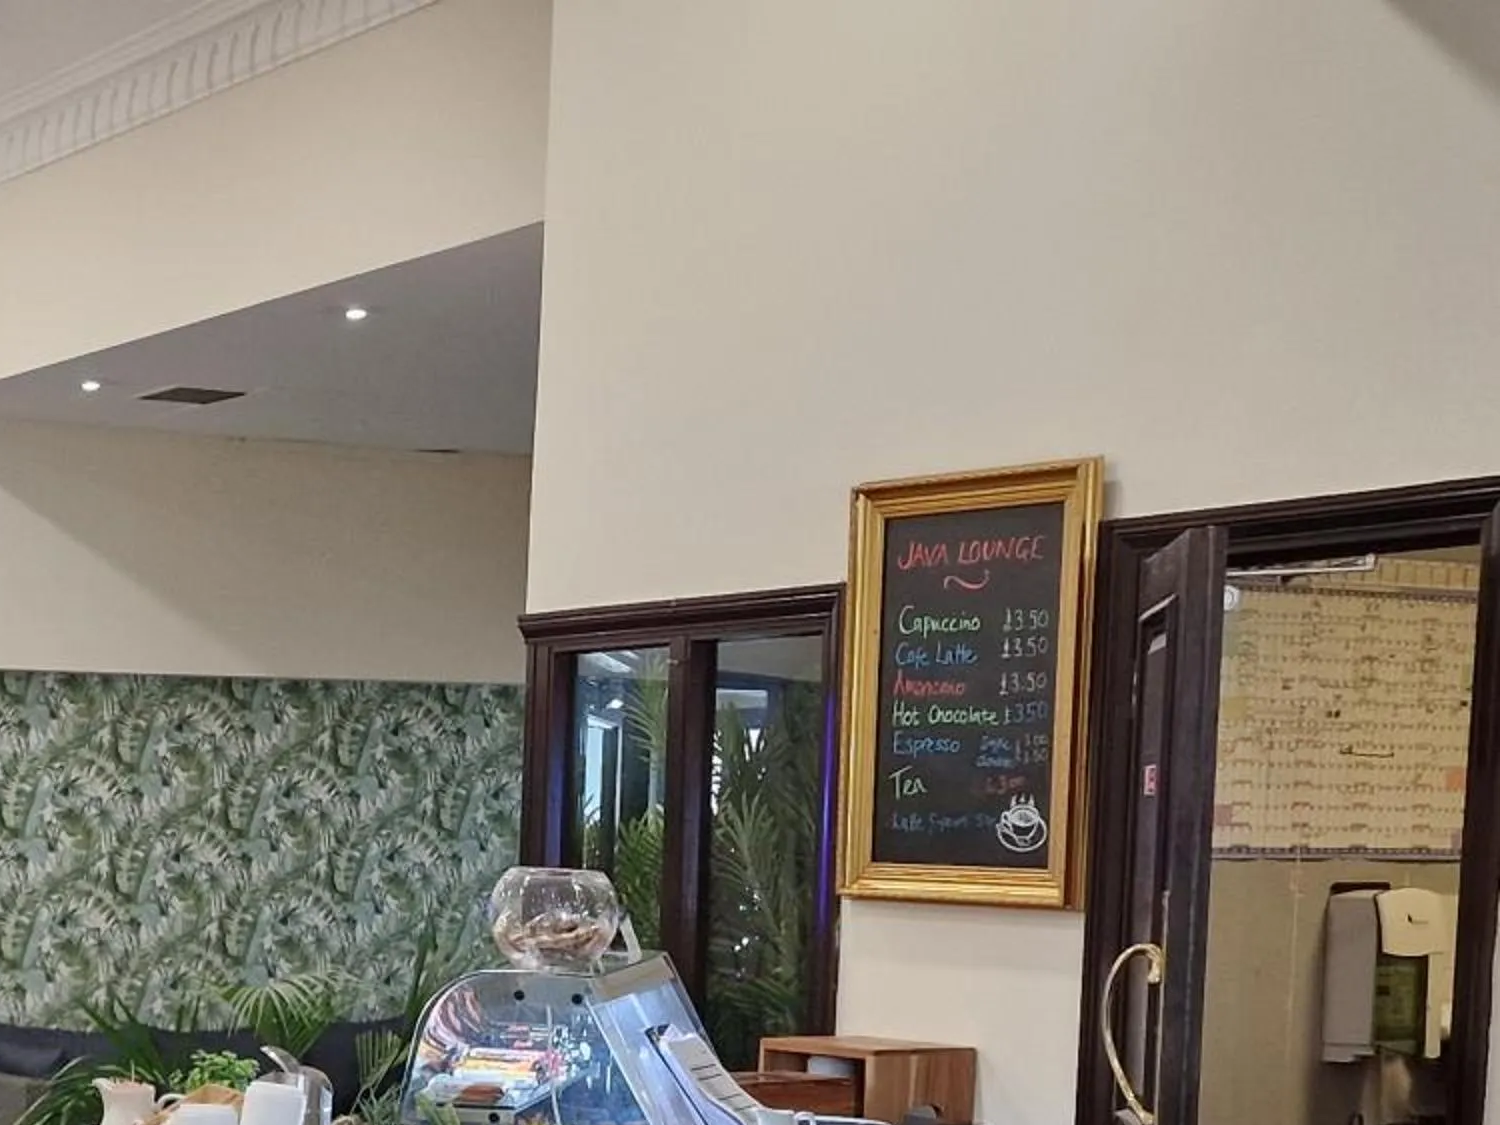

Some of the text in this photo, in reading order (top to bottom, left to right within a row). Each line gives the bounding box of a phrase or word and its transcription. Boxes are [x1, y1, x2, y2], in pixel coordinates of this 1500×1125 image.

[898, 535, 1046, 570] JAVA LOUNGE
[899, 605, 981, 638] Capuccino
[892, 699, 920, 727] Hot
[893, 730, 961, 758] Espresso
[888, 765, 928, 799] Tea
